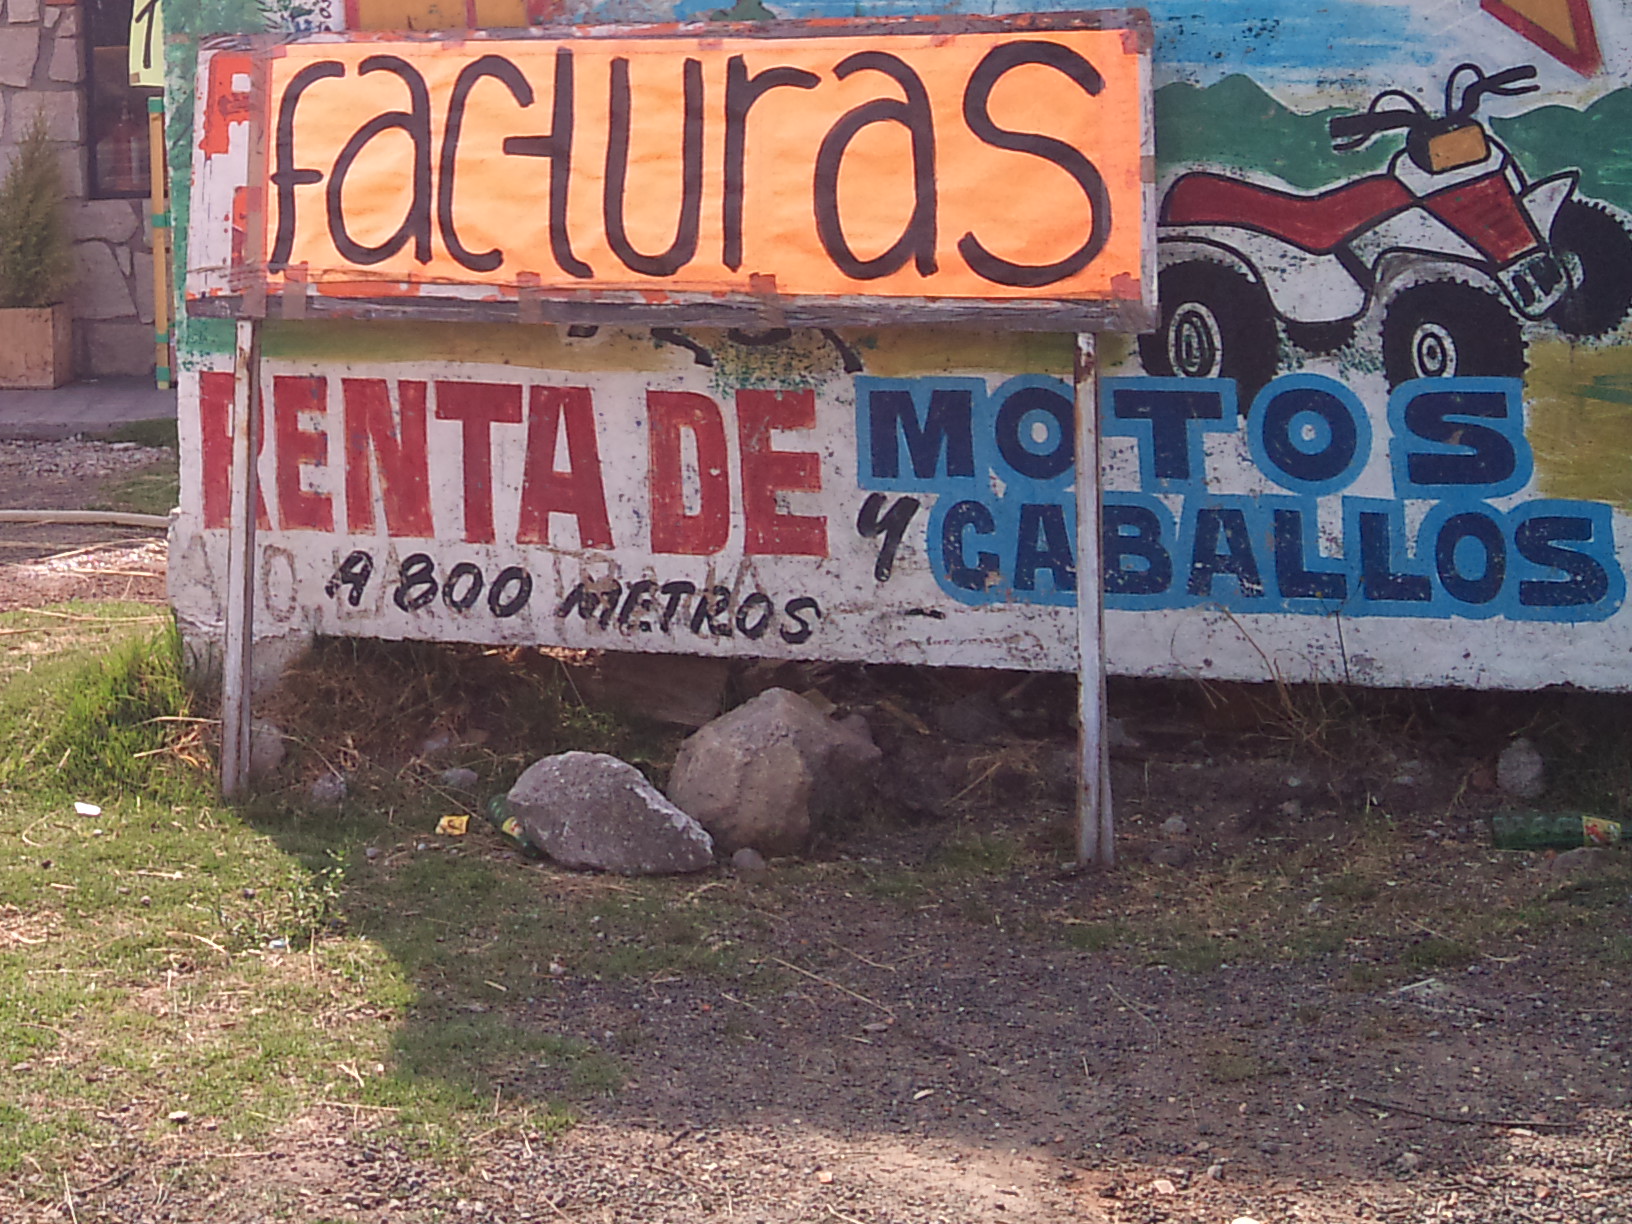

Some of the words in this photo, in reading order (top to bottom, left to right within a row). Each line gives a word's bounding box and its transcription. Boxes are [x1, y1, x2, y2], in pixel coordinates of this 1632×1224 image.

[268, 39, 1112, 288] facturas
[199, 370, 616, 550] RENTA
[646, 386, 829, 557] DE
[855, 373, 1535, 499] MOTOS
[392, 553, 535, 619] 800
[556, 579, 823, 645] METROS
[928, 492, 1626, 622] CABALLOS
